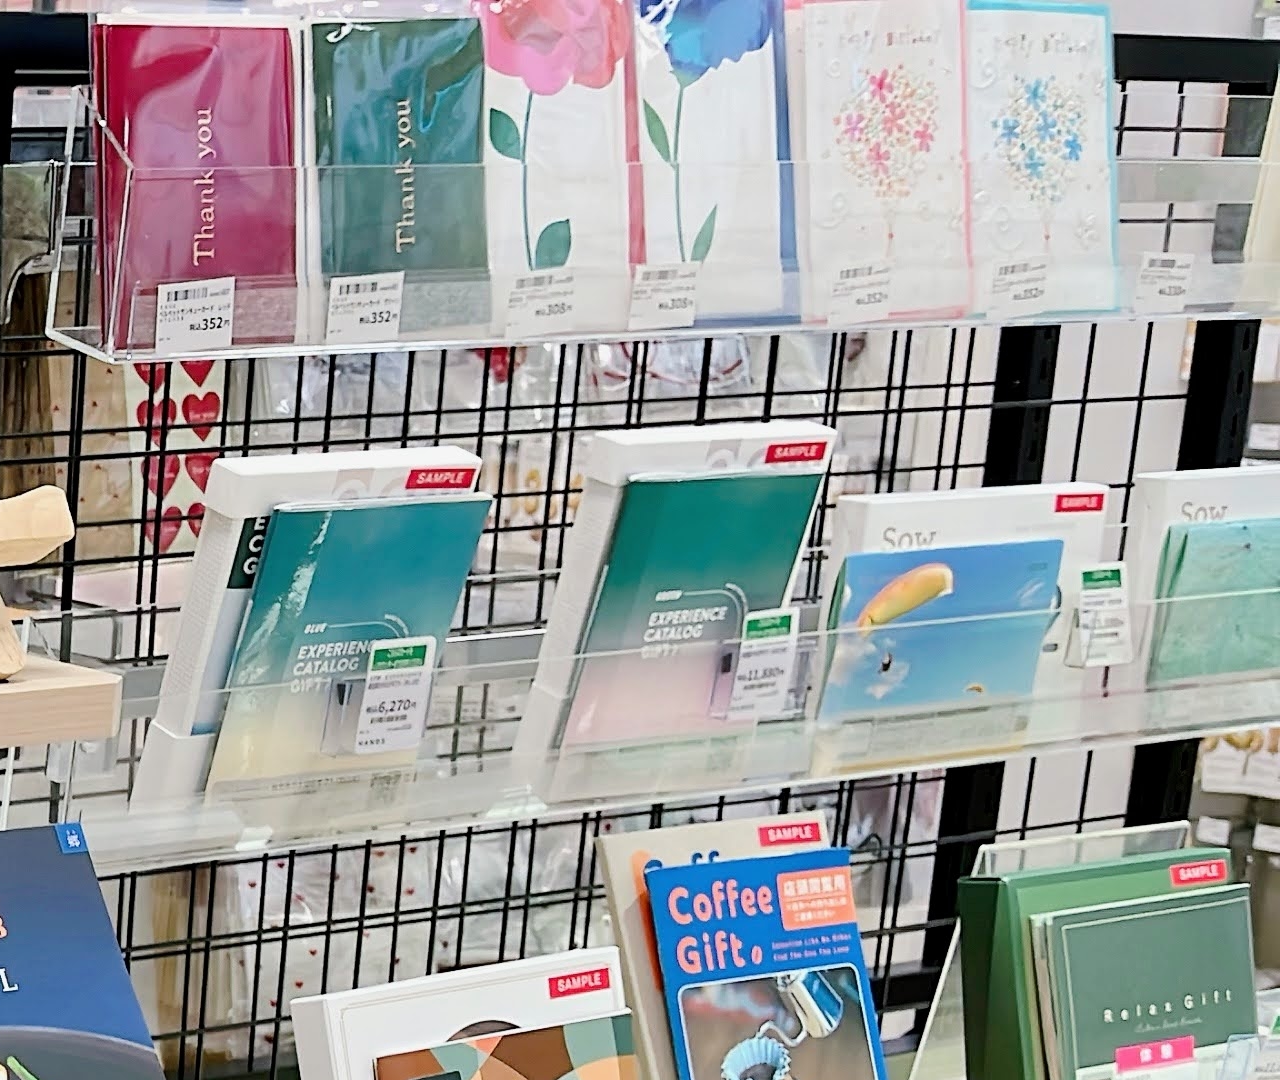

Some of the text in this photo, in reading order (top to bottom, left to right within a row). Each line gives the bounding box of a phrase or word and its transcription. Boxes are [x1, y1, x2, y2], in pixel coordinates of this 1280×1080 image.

[395, 100, 416, 254] Thank you
[193, 107, 217, 267] Thank you
[416, 471, 465, 485] SAMPLE
[648, 606, 728, 626] EXPERIENCE
[643, 624, 703, 642] CATALOG
[293, 658, 359, 676] CATALOG
[767, 826, 814, 842] SAMPLE
[1179, 863, 1219, 881] SAMPLE
[668, 879, 774, 925] Coffee
[557, 973, 603, 994] SAMPLE
